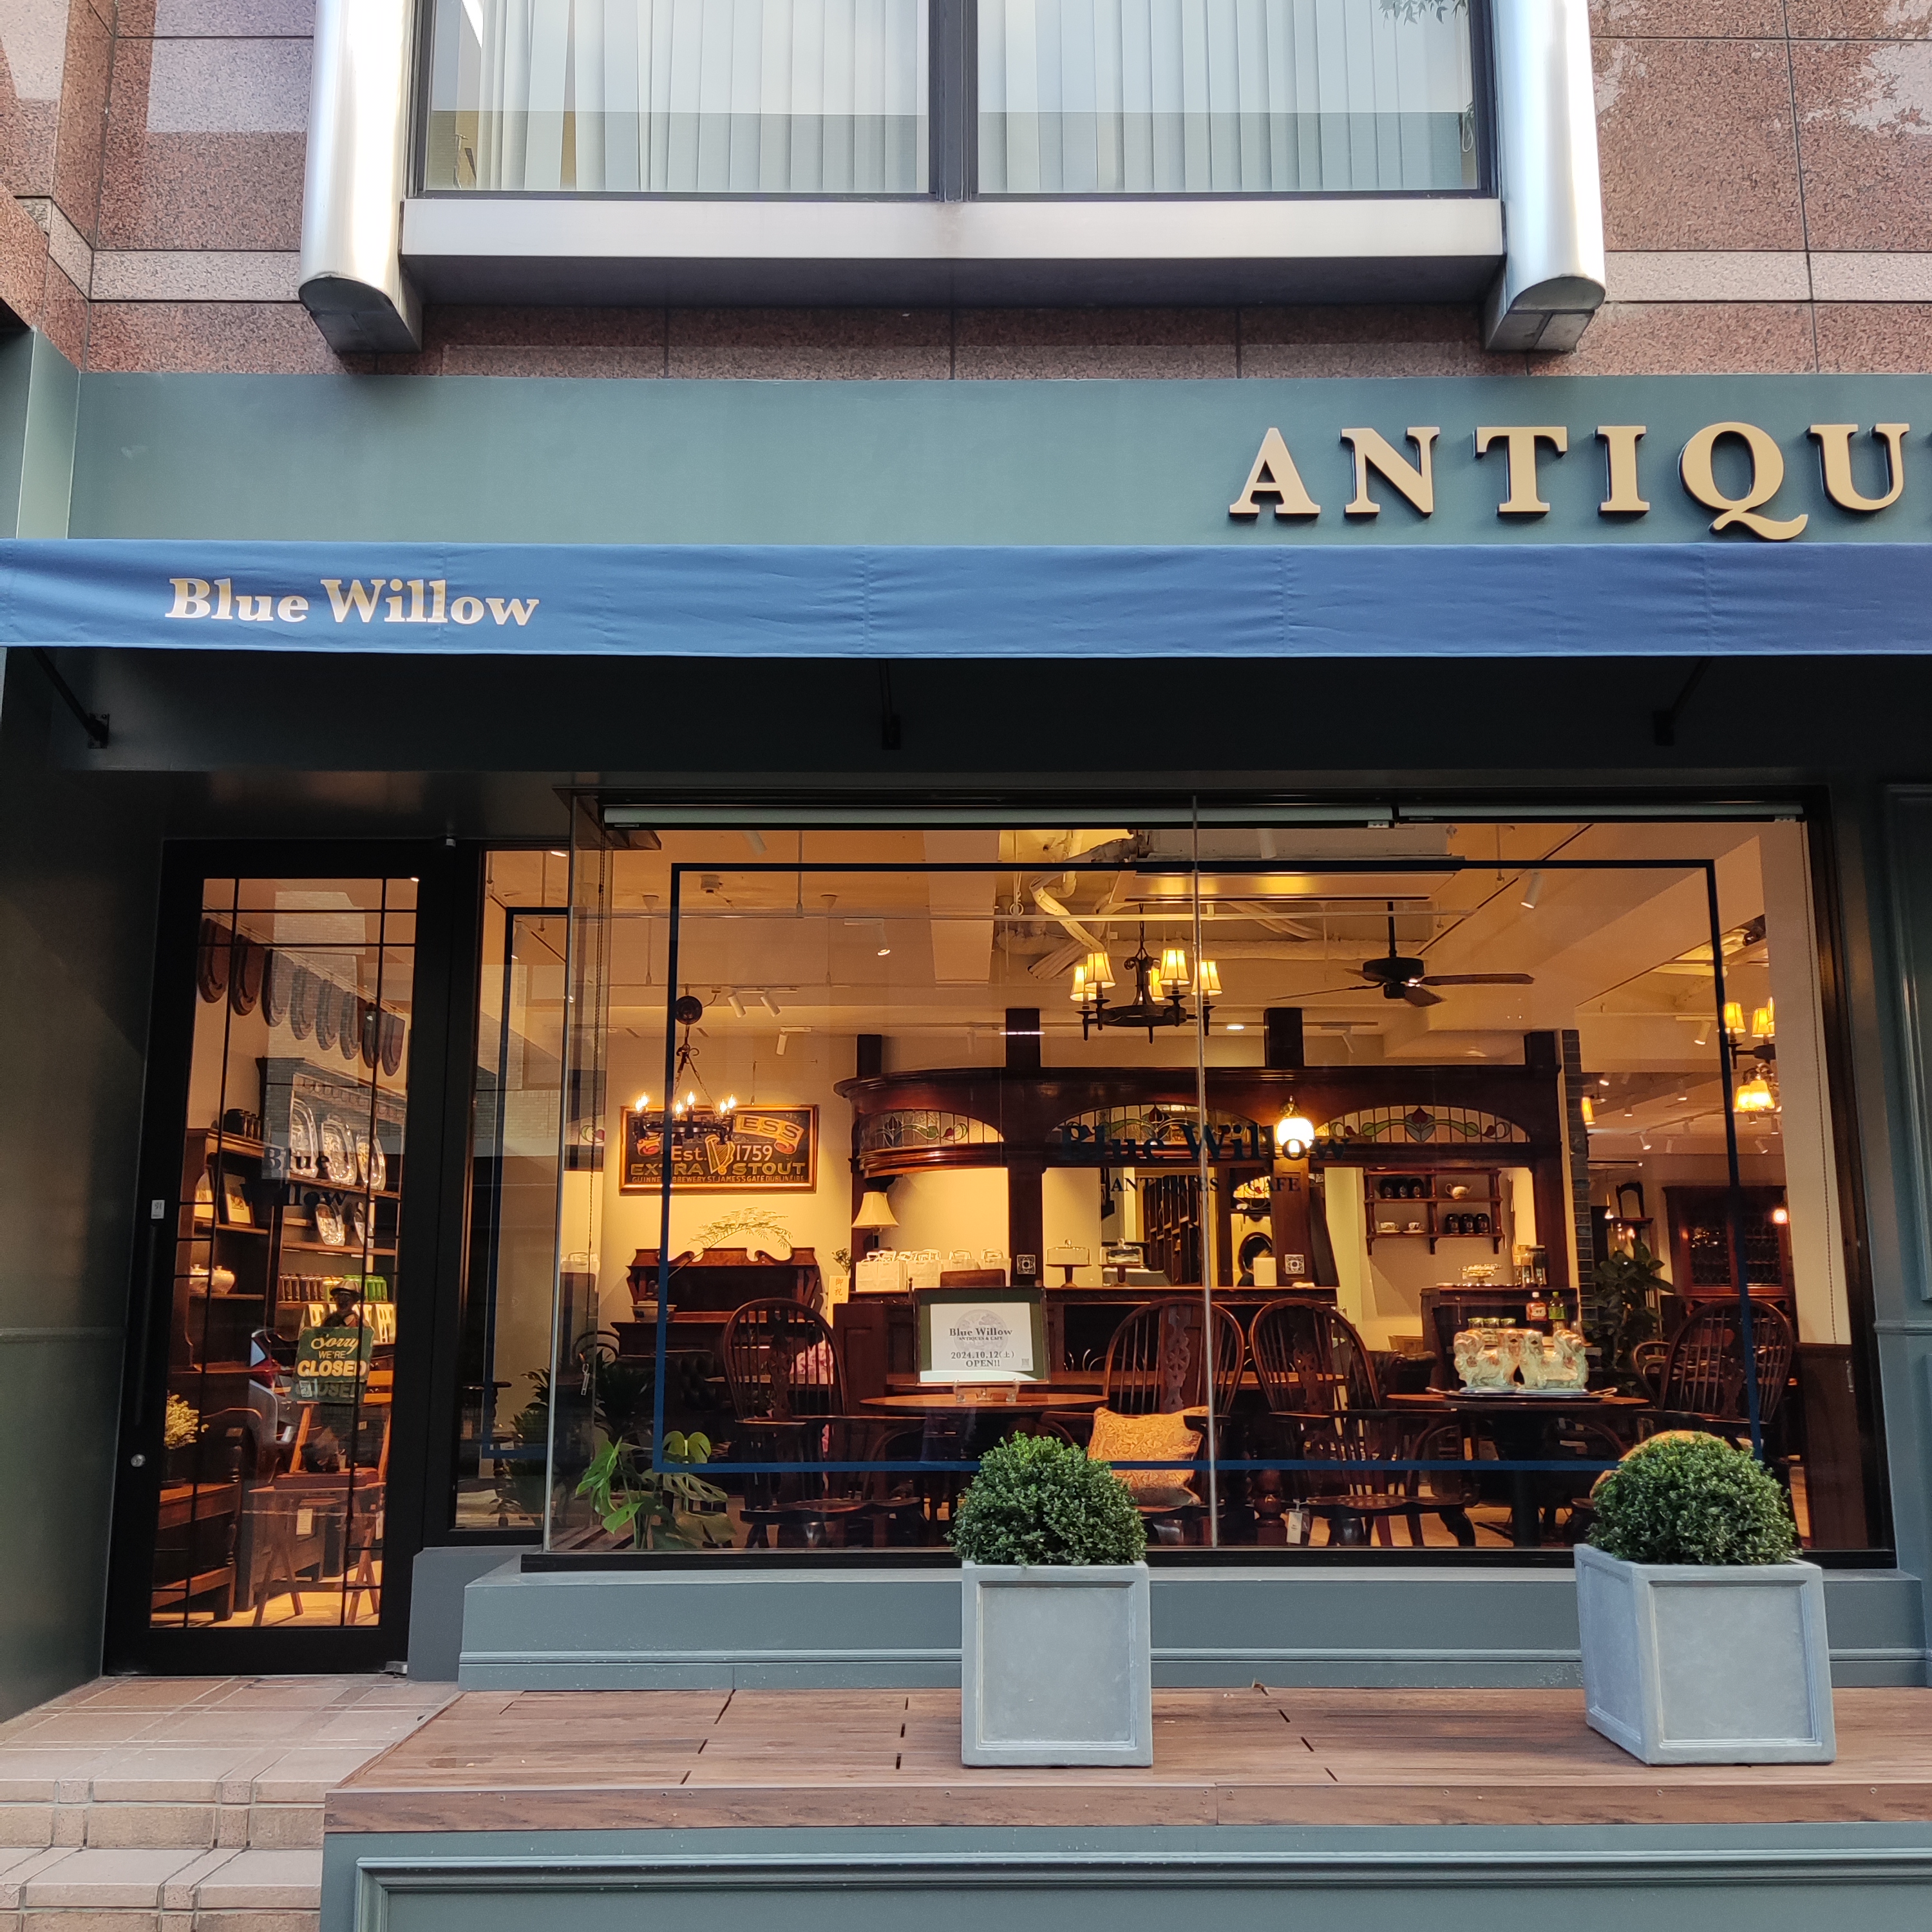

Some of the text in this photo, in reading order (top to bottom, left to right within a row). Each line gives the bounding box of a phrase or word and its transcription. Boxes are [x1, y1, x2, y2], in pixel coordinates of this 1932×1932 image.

[1228, 422, 1910, 540] ANTIQU
[165, 578, 540, 625] Blue Willow
[1057, 1124, 1350, 1161] Blue Willow
[262, 1147, 330, 1170] Blue
[672, 1145, 772, 1161] Est. 1759
[630, 1161, 806, 1176] EXRA STOUT
[240, 1182, 349, 1206] llow
[1248, 1177, 1302, 1192] AFE
[949, 1327, 1013, 1336] Blue Willow
[310, 1334, 359, 1355] Sorry
[318, 1350, 346, 1359] WE'RE
[297, 1360, 367, 1377] CLOSED
